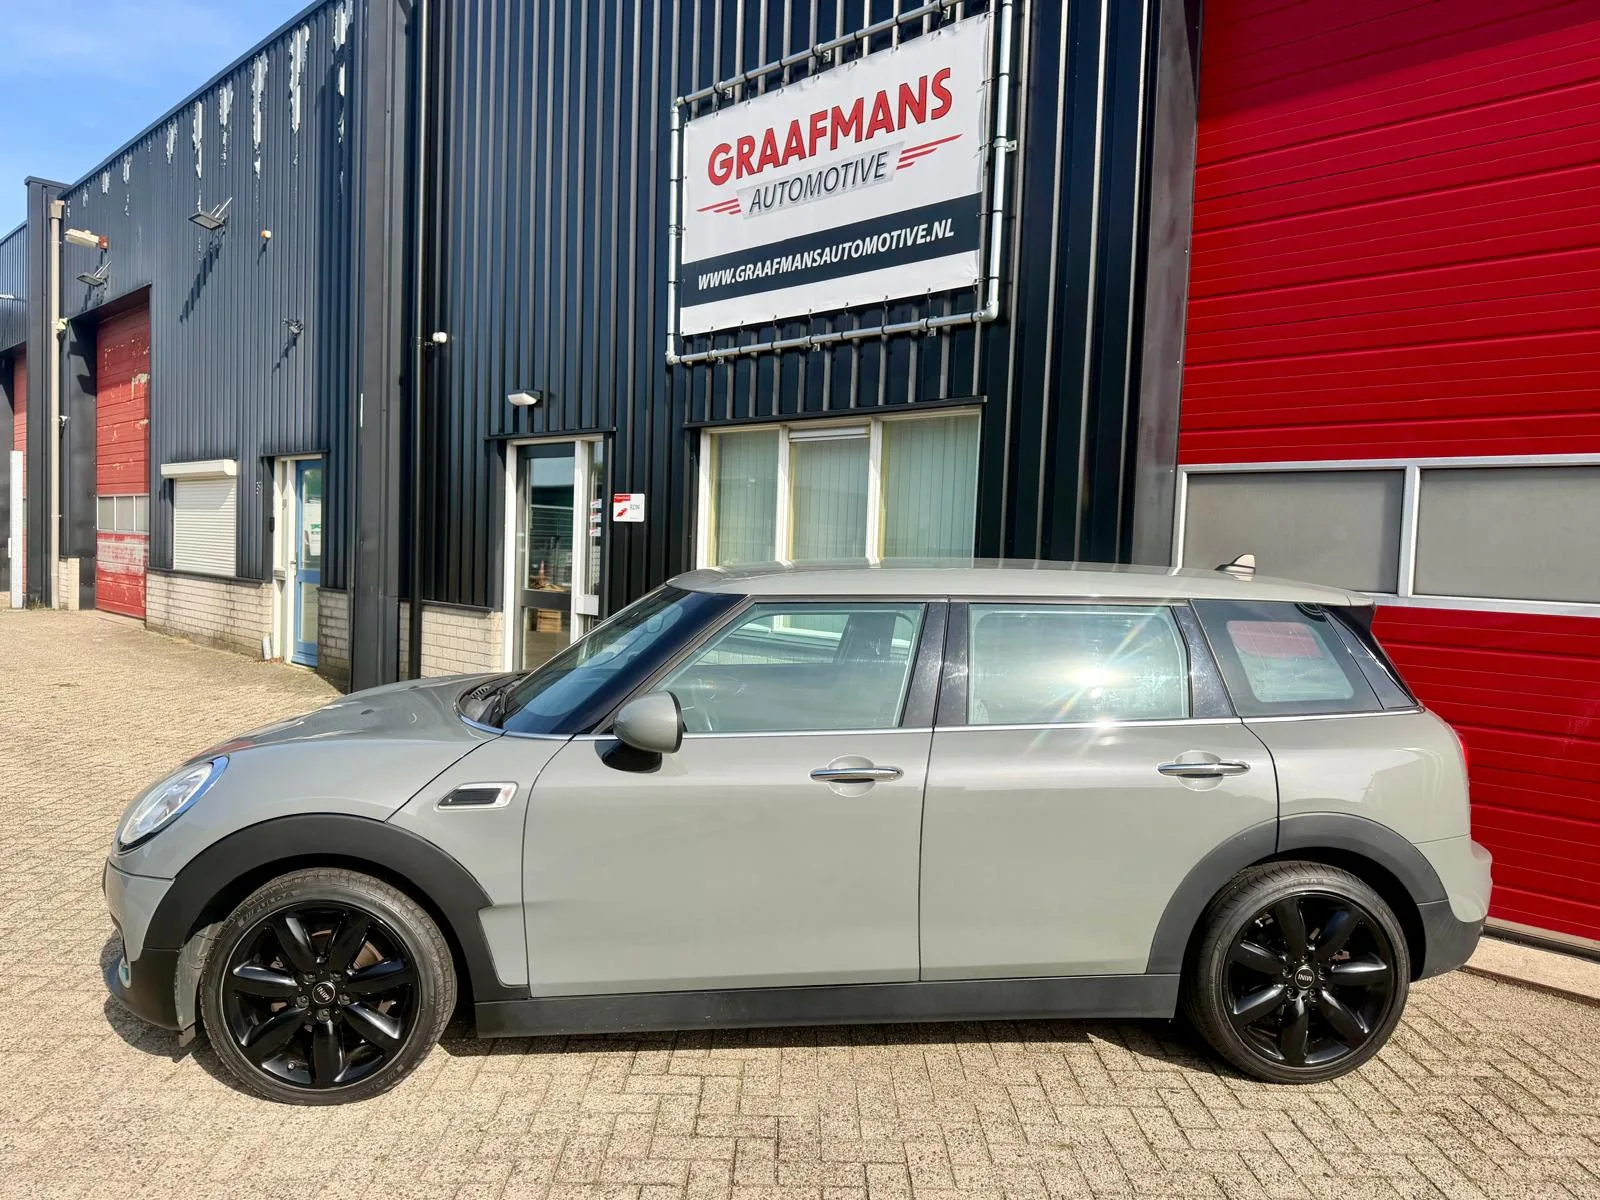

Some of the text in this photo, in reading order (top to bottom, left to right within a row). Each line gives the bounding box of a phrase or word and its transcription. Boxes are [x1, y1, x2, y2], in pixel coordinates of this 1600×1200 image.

[708, 67, 952, 186] GRAAFMANS
[749, 151, 890, 213] AUTOMOTIVE
[698, 218, 954, 291] WWW.GRAAFMANSAUTOMOTIVE.NL
[316, 986, 331, 1001] MINI
